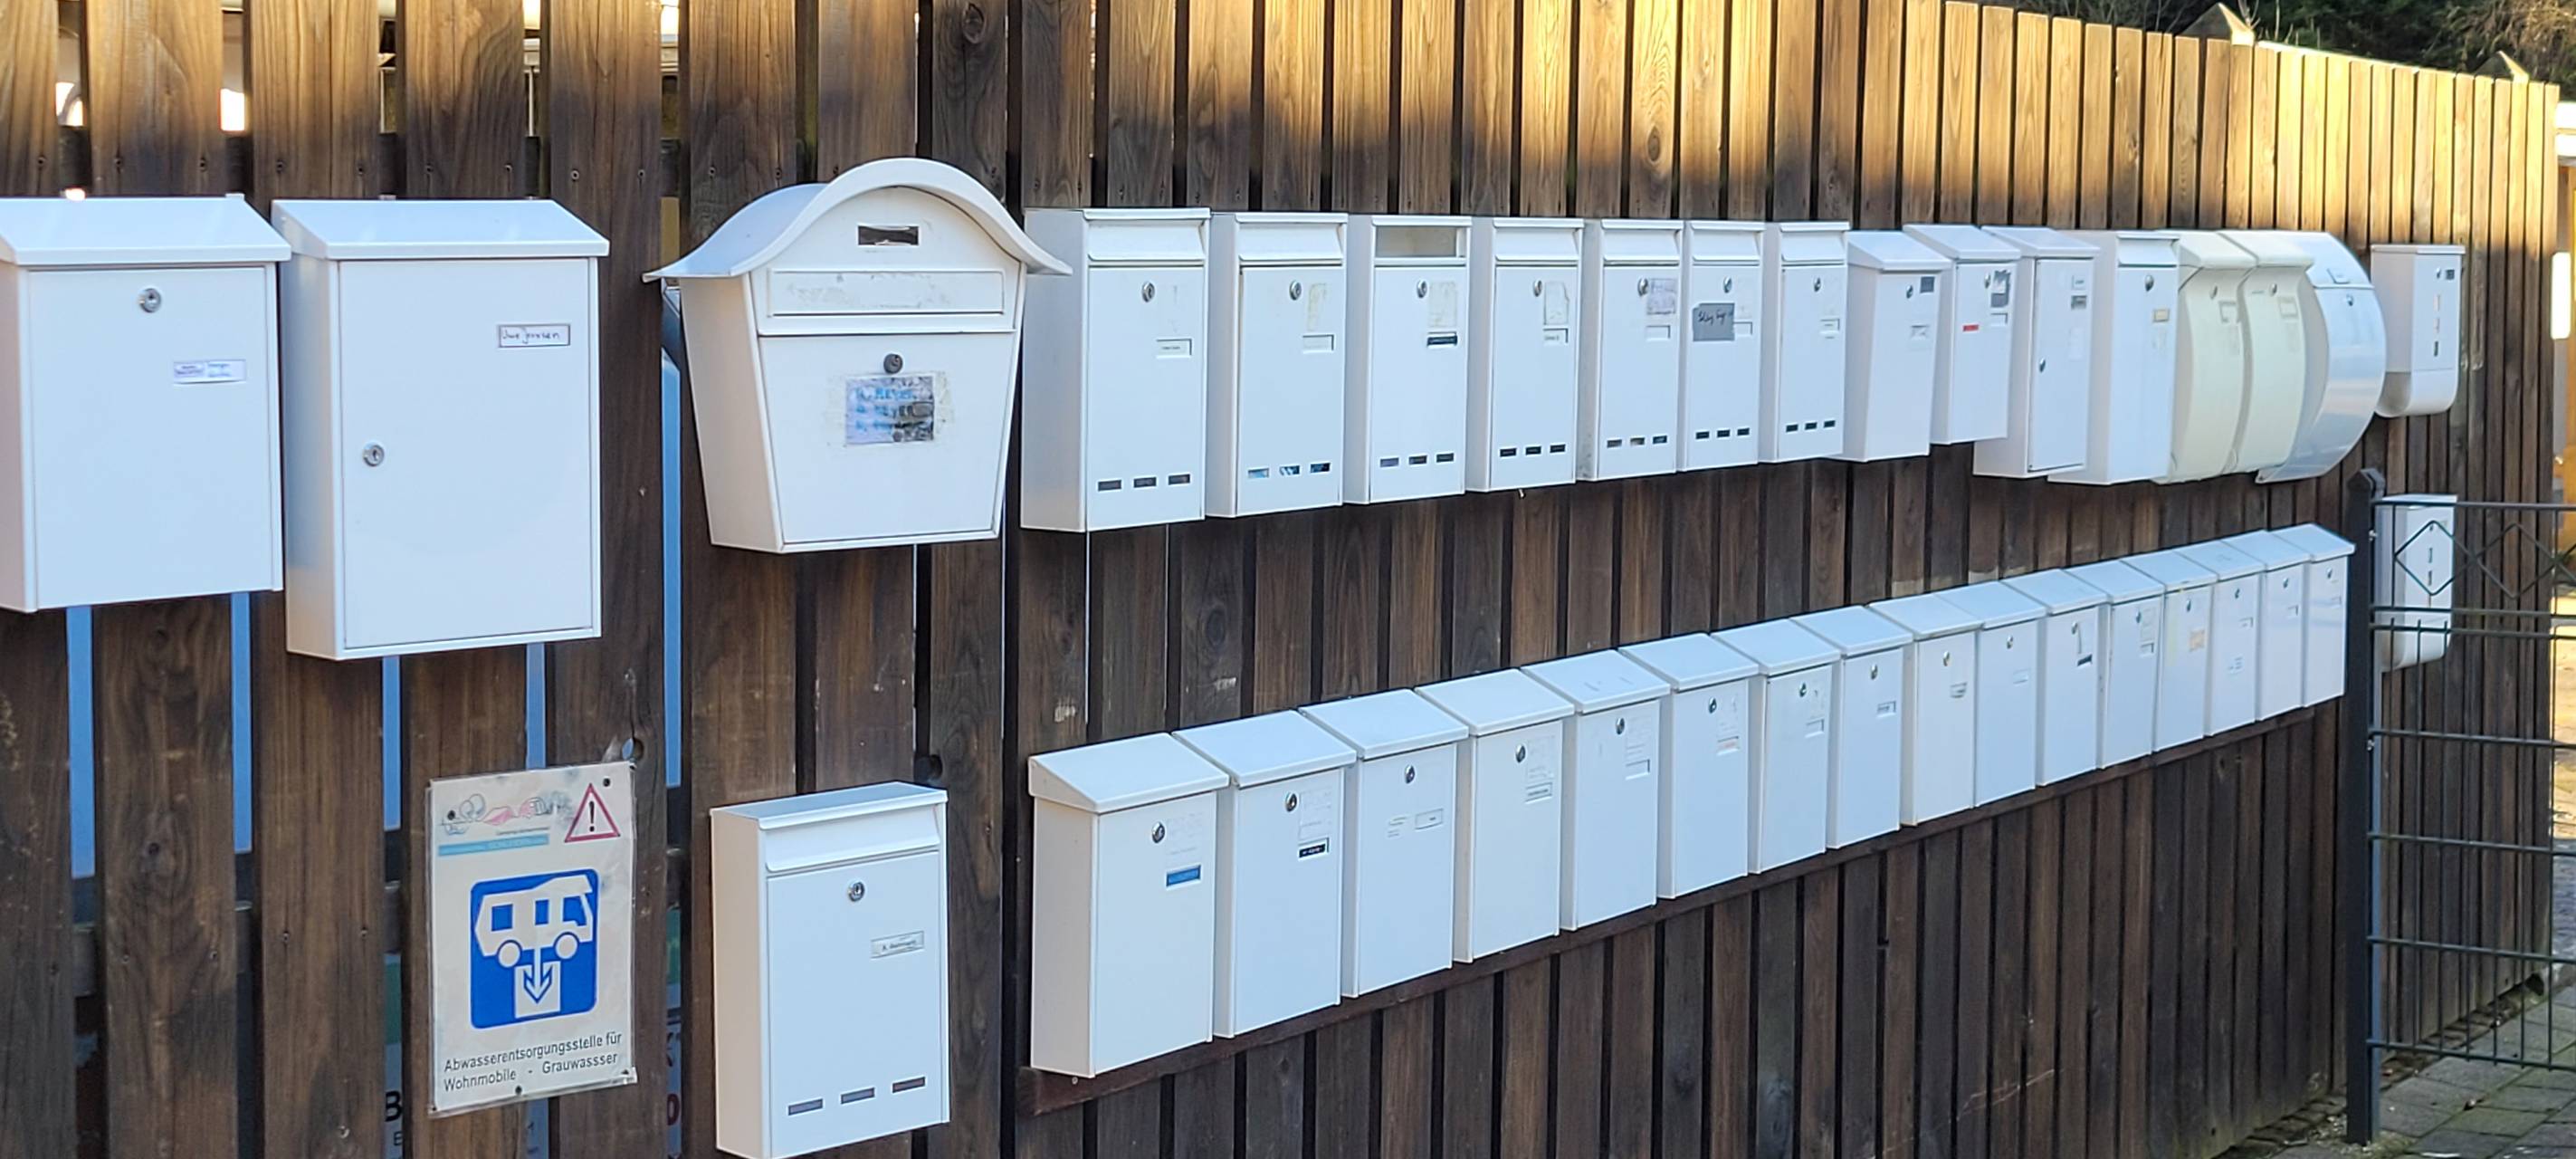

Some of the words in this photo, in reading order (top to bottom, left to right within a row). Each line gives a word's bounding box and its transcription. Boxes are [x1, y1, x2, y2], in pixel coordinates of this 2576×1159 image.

[444, 1034, 603, 1073] Abwasserentsorgungsstelle
[606, 1030, 623, 1046] für
[444, 1068, 517, 1092] Wohnmobile
[542, 1051, 618, 1075] Grauwassser
